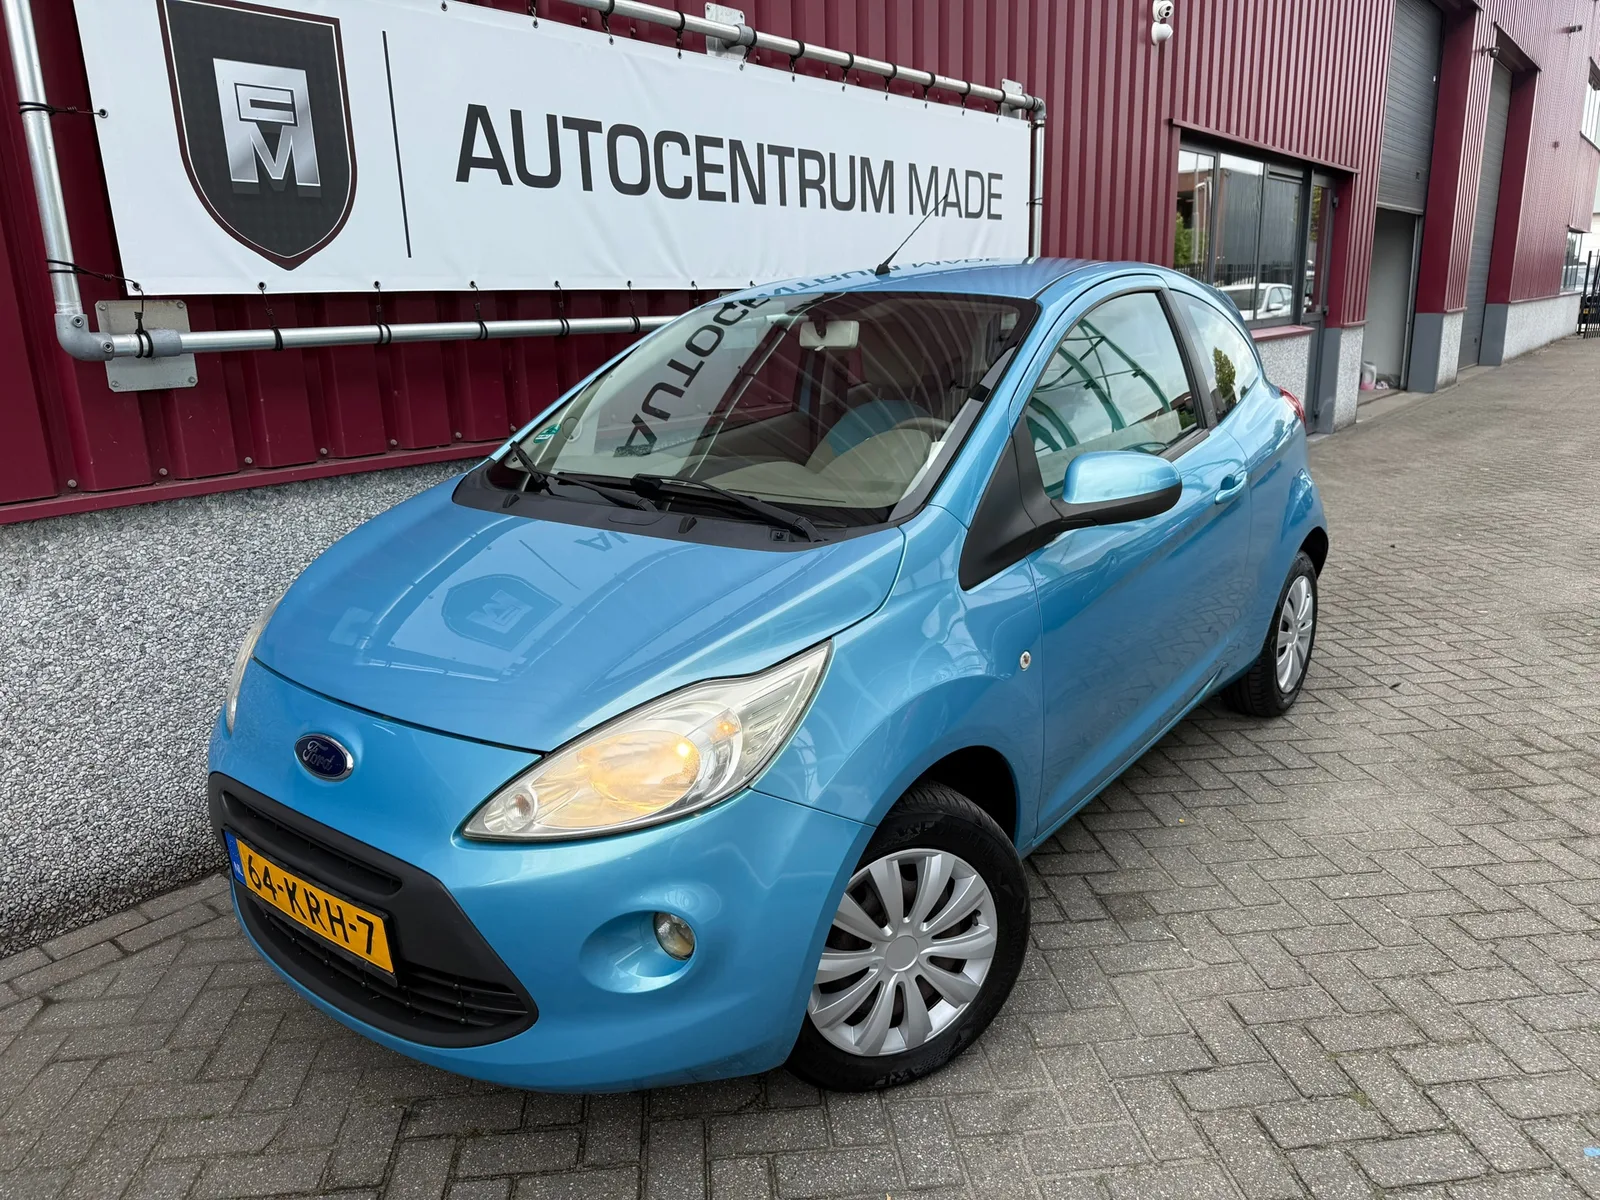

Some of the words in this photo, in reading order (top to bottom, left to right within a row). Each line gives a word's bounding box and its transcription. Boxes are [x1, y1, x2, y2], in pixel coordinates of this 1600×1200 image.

[456, 103, 896, 215] AUTOCENTRUM
[908, 163, 1004, 221] MADE
[247, 854, 374, 956] 64-KRH-7
